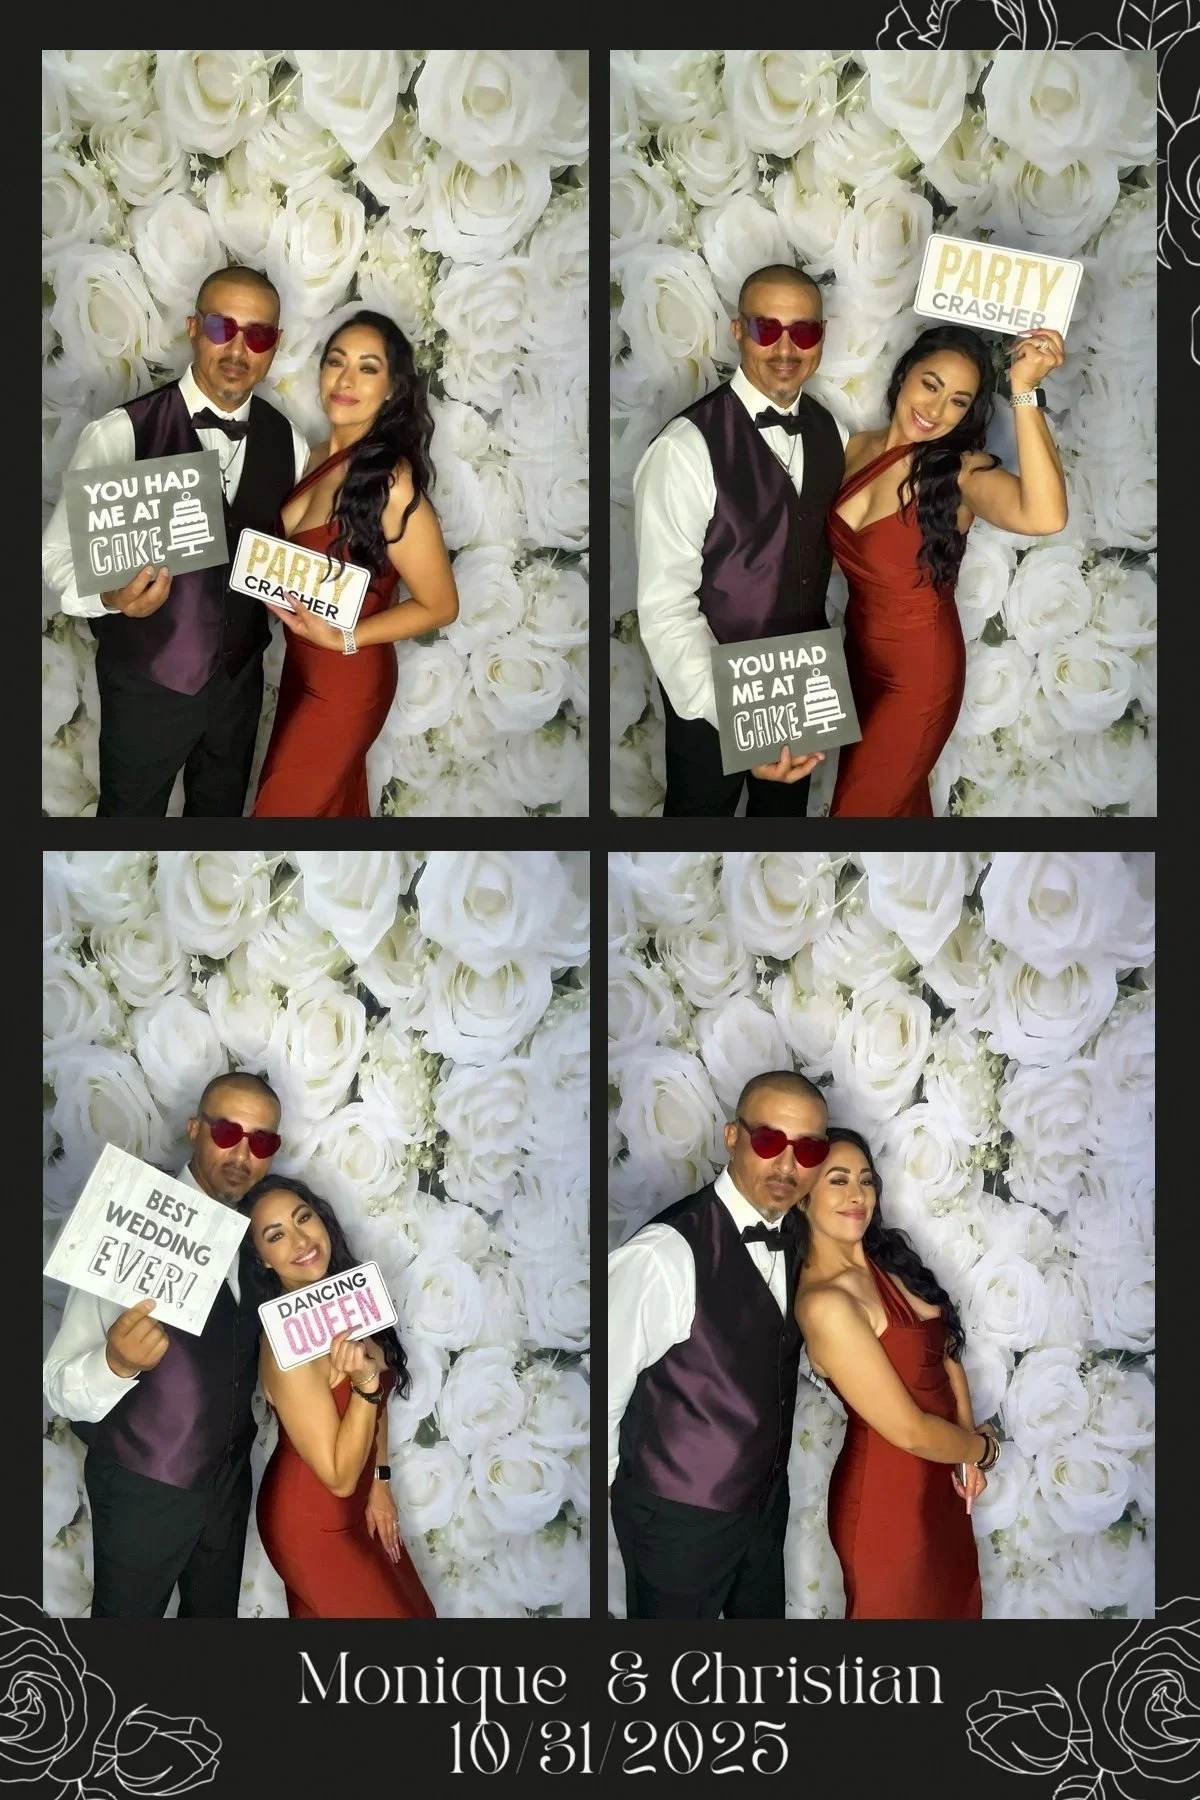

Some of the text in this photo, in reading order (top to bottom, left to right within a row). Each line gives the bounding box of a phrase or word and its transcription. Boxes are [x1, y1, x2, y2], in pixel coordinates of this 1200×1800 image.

[934, 244, 1064, 312] PARTY
[932, 292, 1046, 330] CRASHER
[83, 468, 200, 505] YOU HAD
[88, 499, 161, 532] ME AT
[89, 526, 166, 577] CAKE
[246, 538, 355, 605] PARTY
[728, 645, 827, 679] YOU HAD
[732, 675, 795, 706] ME AT
[733, 702, 803, 752] CAKE
[145, 1189, 198, 1228] BEST
[105, 1200, 212, 1267] WEDDING
[87, 1235, 198, 1310] EVER!
[277, 1272, 367, 1320] DANCING
